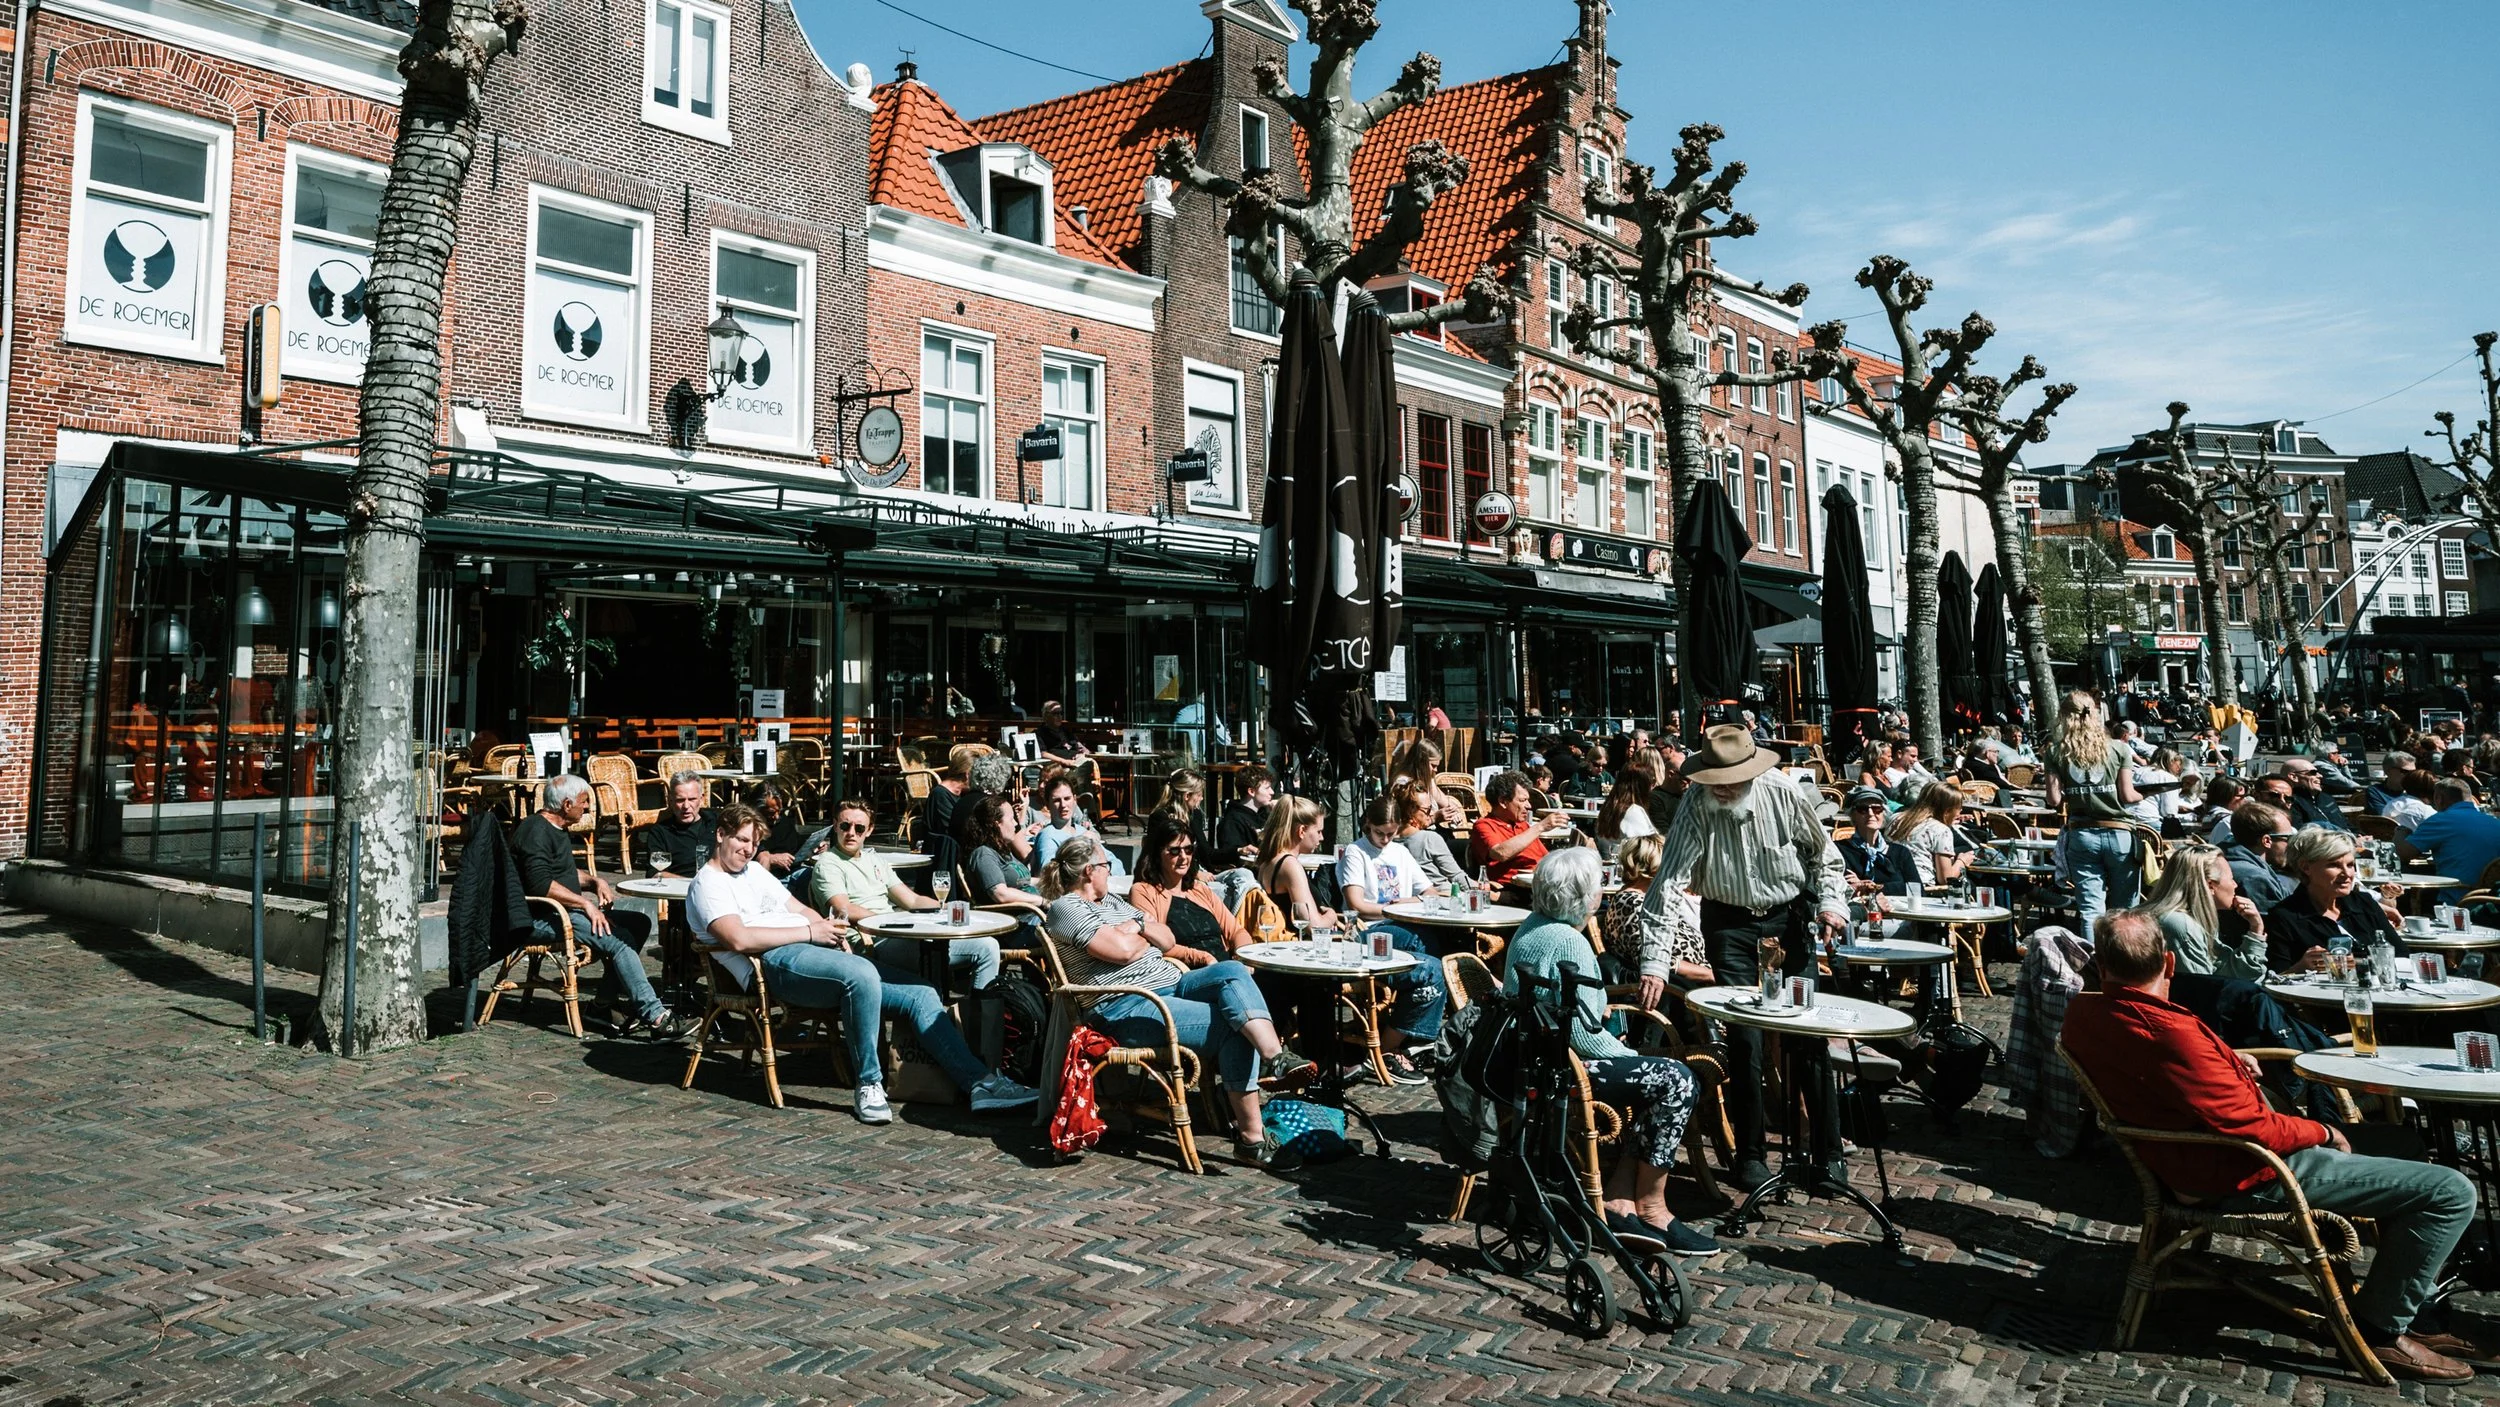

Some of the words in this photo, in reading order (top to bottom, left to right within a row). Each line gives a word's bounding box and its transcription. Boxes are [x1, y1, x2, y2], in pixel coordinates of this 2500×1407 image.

[79, 295, 105, 317] DE
[113, 301, 191, 331] ROEMER
[287, 330, 310, 350] DE
[317, 335, 371, 358] ROEME
[538, 364, 556, 382] DE
[561, 368, 614, 391] ROEMER
[717, 395, 732, 410] DE
[736, 397, 783, 416] ROEMER
[872, 427, 896, 440] Trappe
[1024, 435, 1058, 449] Bavaria
[1173, 458, 1206, 470] Bavaria
[1477, 506, 1507, 514] AMSTEL
[1594, 543, 1619, 562] Casino
[2159, 637, 2199, 648] VENEZIA
